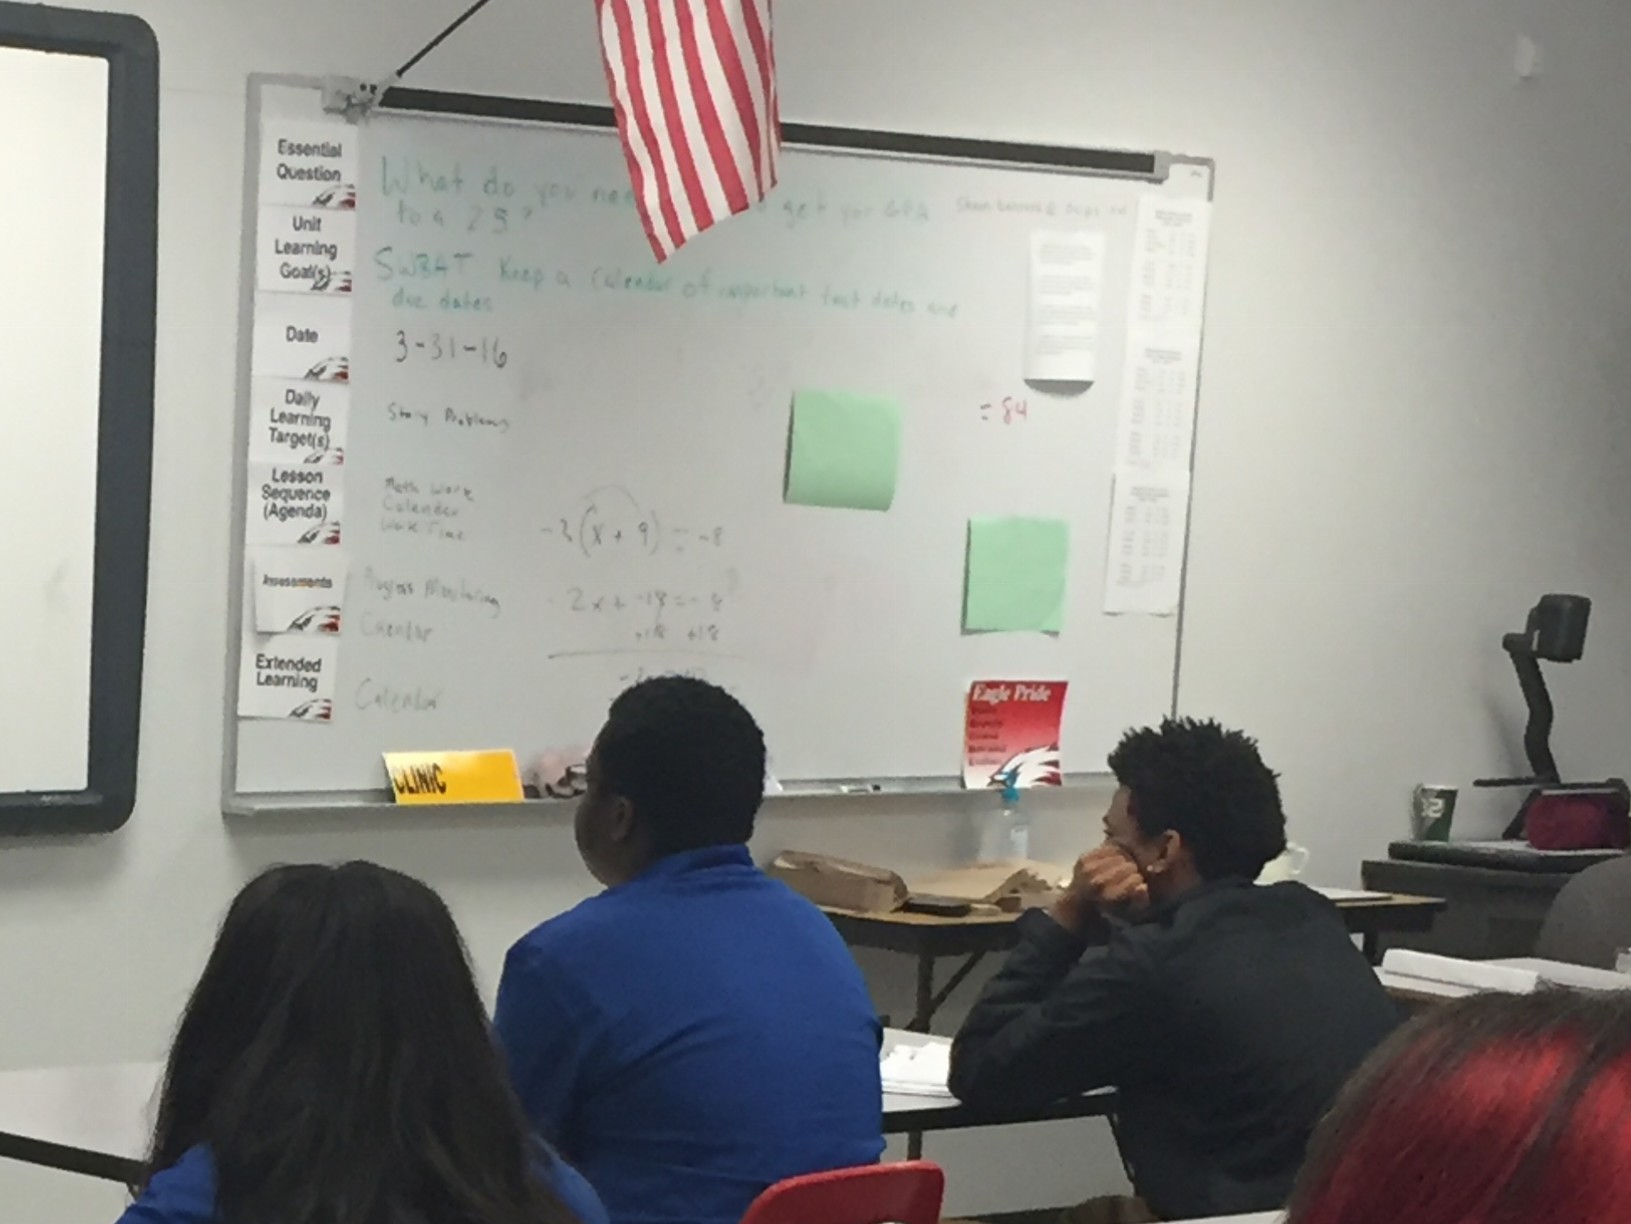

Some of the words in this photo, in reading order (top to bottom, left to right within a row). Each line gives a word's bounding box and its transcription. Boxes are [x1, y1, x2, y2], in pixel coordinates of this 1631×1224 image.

[277, 138, 343, 158] Essential
[276, 163, 342, 182] Question
[380, 155, 464, 197] What
[482, 164, 516, 198] do
[292, 215, 322, 232] Unit
[274, 239, 338, 261] Learning
[279, 262, 331, 281] Goal(s)
[286, 325, 319, 344] Date
[285, 388, 321, 412] Daily
[270, 407, 332, 433] Learning
[268, 426, 330, 451] Target(s)
[271, 467, 324, 484] Lesson
[261, 483, 331, 504] Sequence
[263, 502, 328, 522] (Agenda)
[255, 653, 322, 673] Extended
[256, 671, 319, 693] Learning
[971, 683, 1011, 706] Eagle
[1013, 683, 1053, 702] Pride
